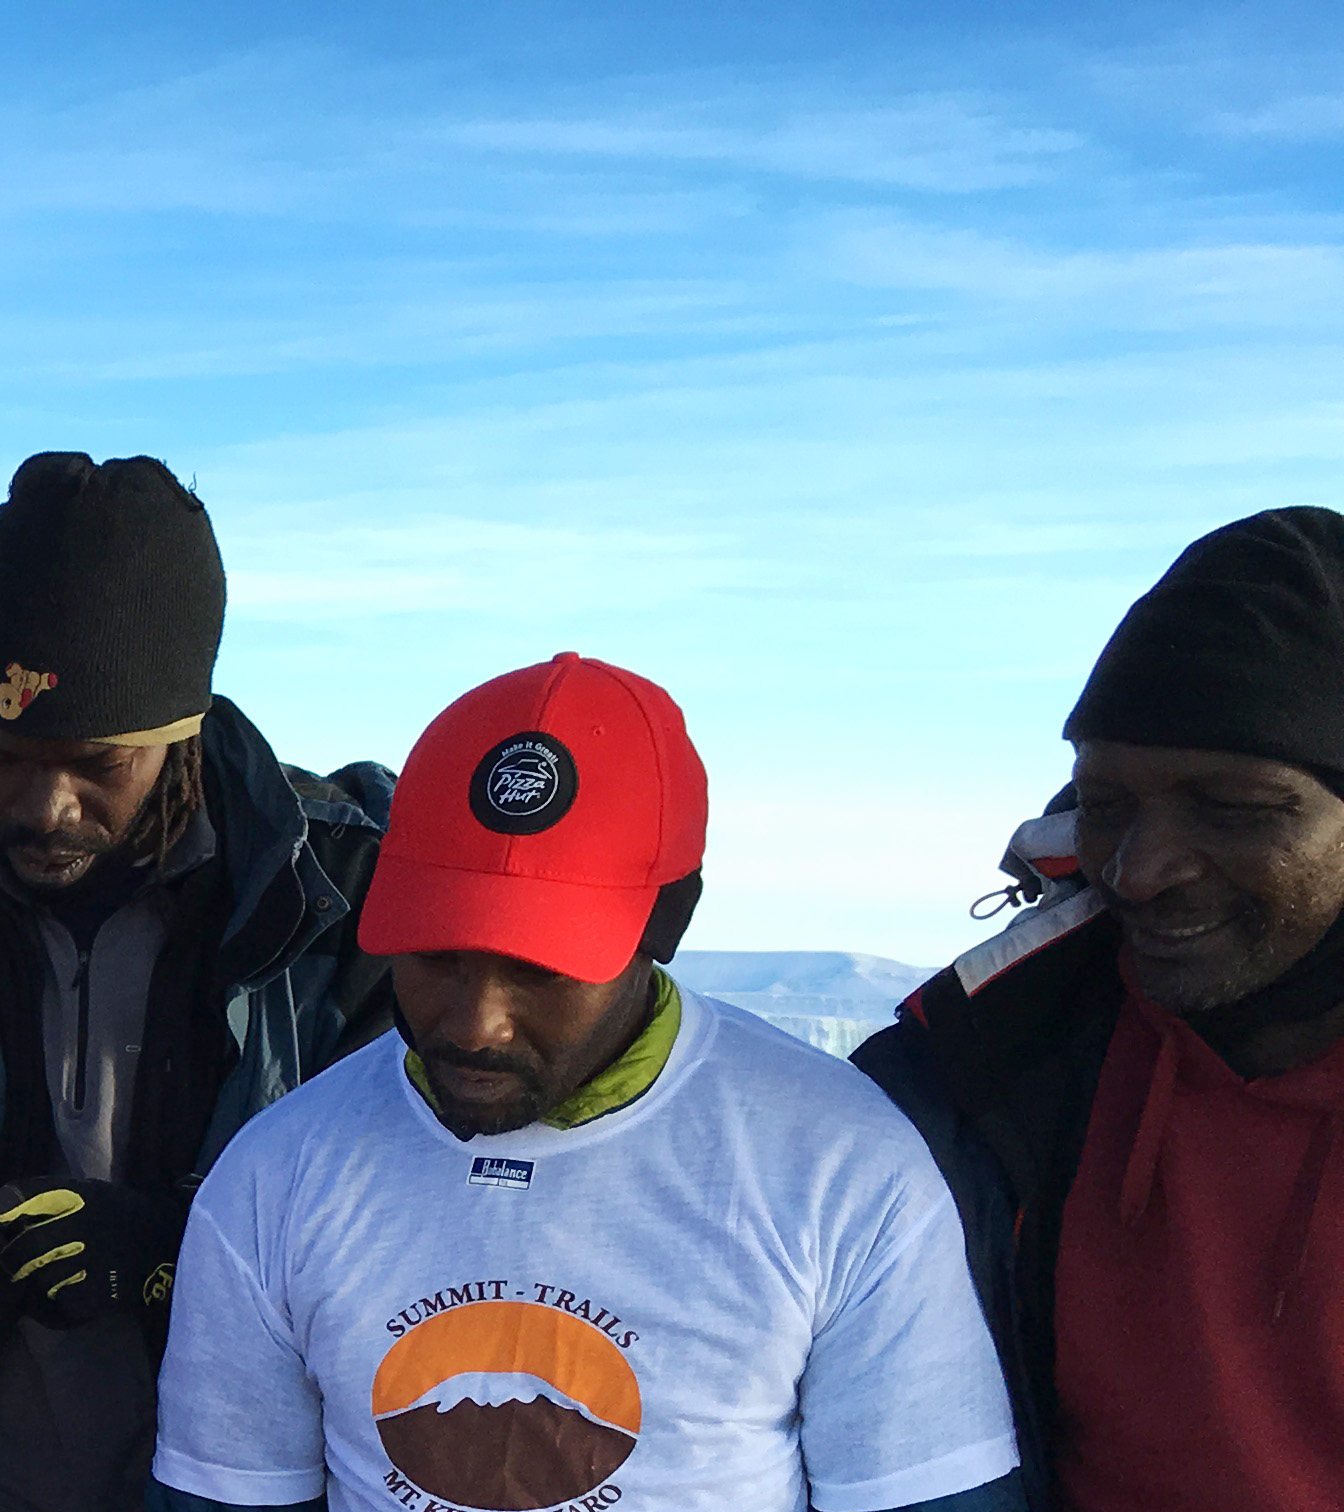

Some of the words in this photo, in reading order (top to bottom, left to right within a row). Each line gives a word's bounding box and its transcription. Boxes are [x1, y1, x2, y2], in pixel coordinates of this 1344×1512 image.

[493, 773, 546, 792] Pizza
[498, 788, 539, 805] Hut
[386, 1280, 508, 1338] SUMMIT
[534, 1283, 640, 1349] TRAILS
[382, 1469, 422, 1511] MT.
